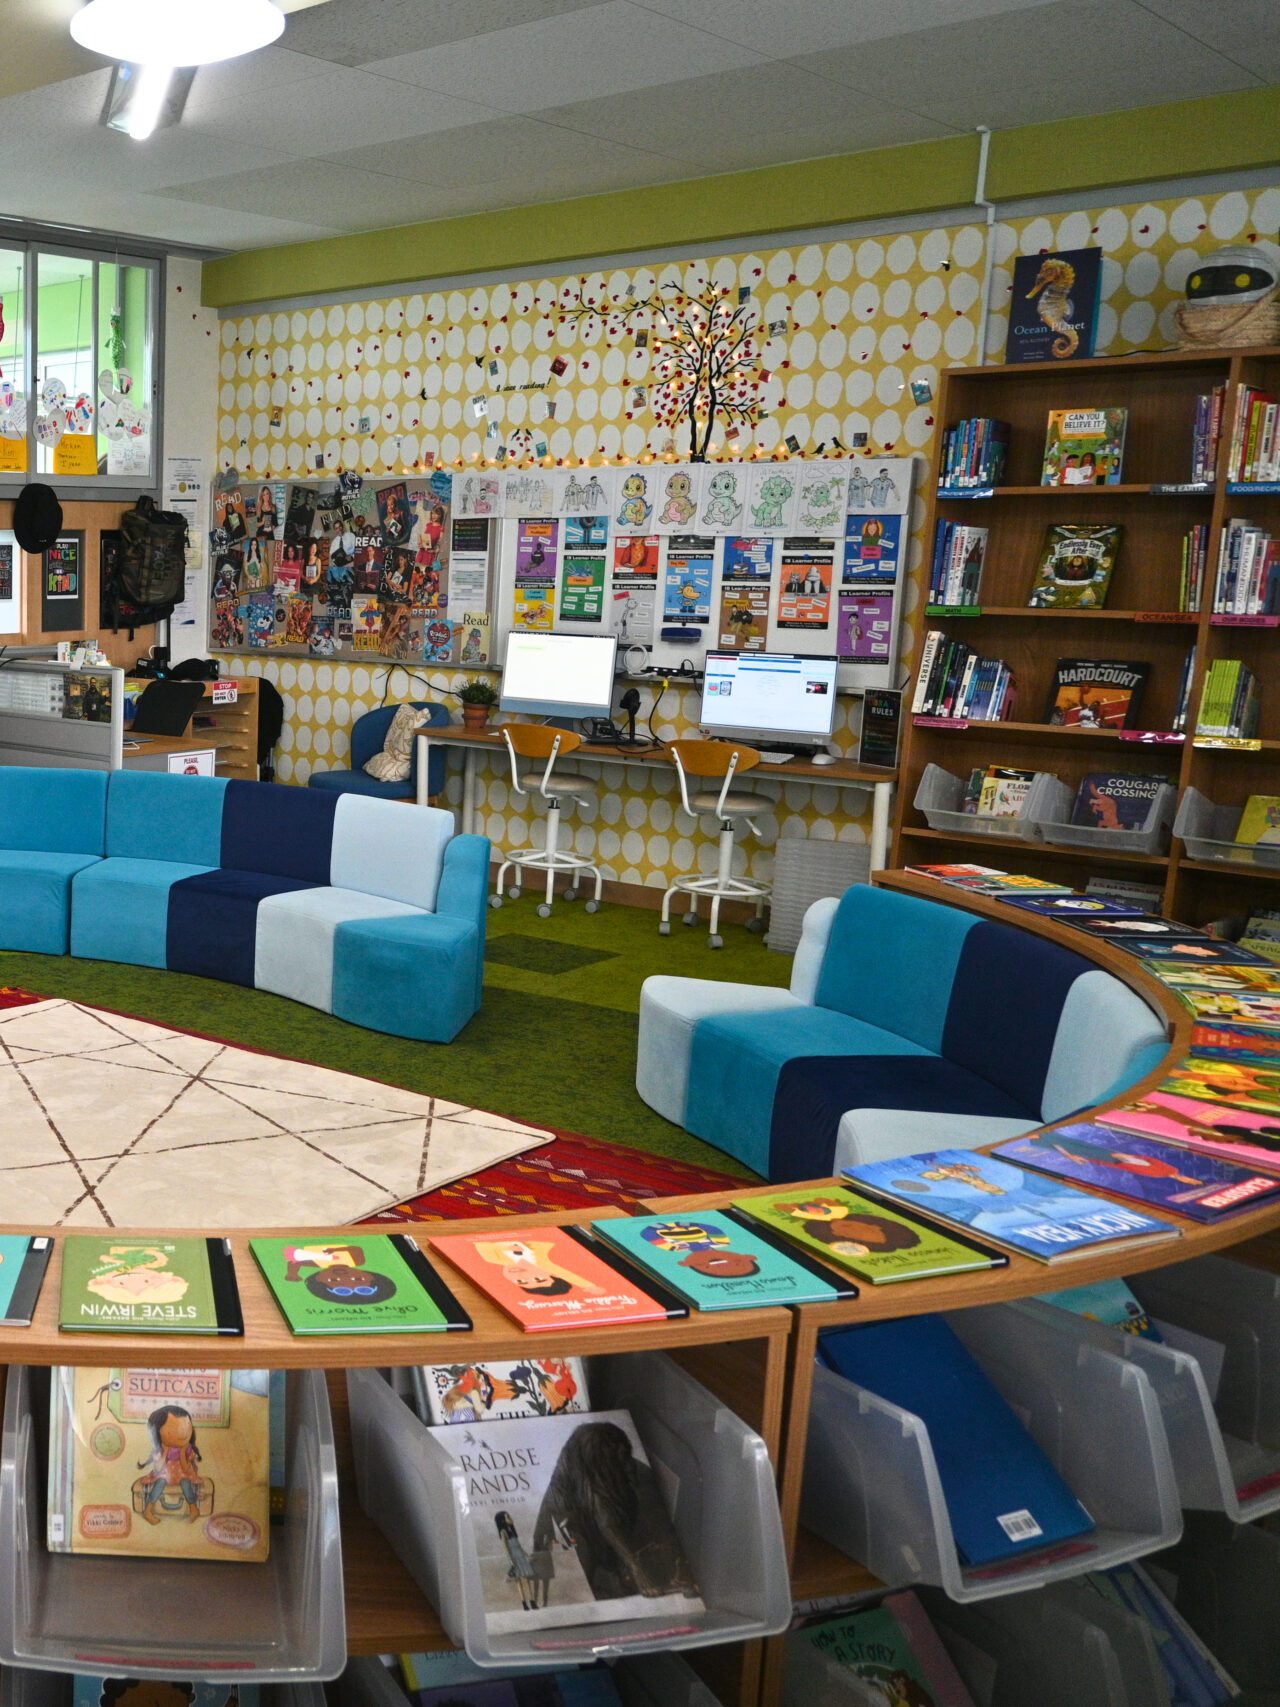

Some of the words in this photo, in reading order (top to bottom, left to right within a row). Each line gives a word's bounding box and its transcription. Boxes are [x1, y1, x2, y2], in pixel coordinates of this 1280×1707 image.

[1014, 324, 1048, 336] Ocean
[1051, 321, 1086, 332] Planet
[1064, 421, 1093, 429] BELIEVE
[1094, 420, 1106, 428] IT?
[216, 492, 242, 511] READ
[355, 536, 383, 547] READ
[49, 549, 76, 560] NICE
[48, 573, 76, 592] KIND
[412, 608, 438, 618] READ
[463, 614, 490, 627] Read
[920, 644, 934, 684] UNIVERSE
[1058, 667, 1142, 688] HARDCOURT
[871, 706, 893, 716] RULES
[1108, 778, 1160, 790] COUGAR
[1096, 787, 1156, 799] CROSSING
[1199, 1176, 1277, 1208] CLASSIFIED
[518, 1300, 586, 1310] Mercury
[584, 1295, 638, 1305] Freddie
[80, 1304, 135, 1316] IRWIN
[141, 1305, 197, 1318] STEVE
[373, 1305, 418, 1314] Olive
[128, 1378, 218, 1396] SUITCASE
[491, 1495, 526, 1506] PINFOLD
[811, 1630, 836, 1650] HOW
[840, 1625, 856, 1639] TO
[834, 1646, 849, 1662] A
[849, 1642, 896, 1663] STORY
